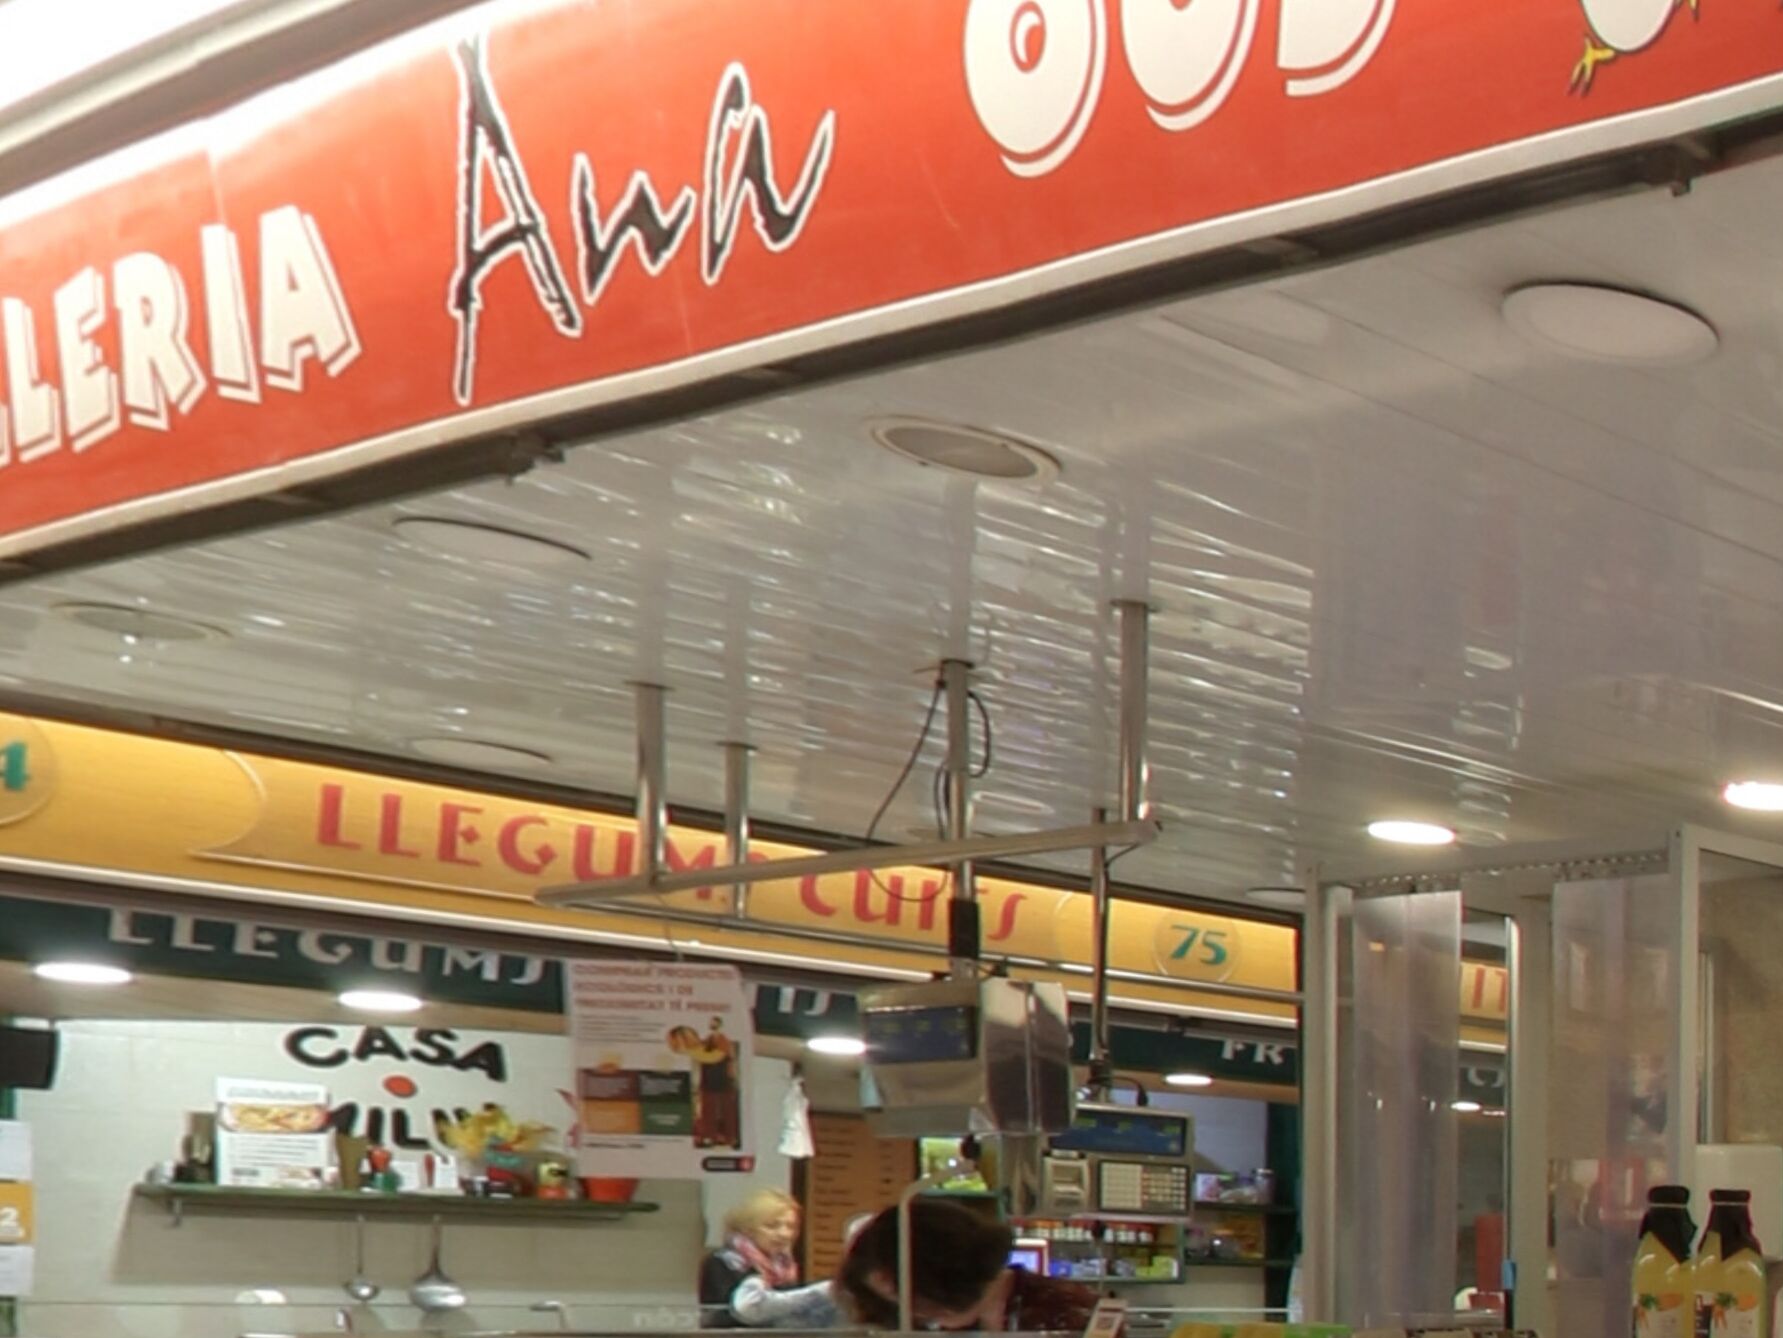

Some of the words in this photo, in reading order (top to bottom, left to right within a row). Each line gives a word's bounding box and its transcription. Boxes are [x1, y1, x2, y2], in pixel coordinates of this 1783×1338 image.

[0, 204, 362, 470] LERIA
[448, 32, 836, 407] Ana
[1169, 923, 1229, 966] 75
[285, 1024, 509, 1082] CASA
